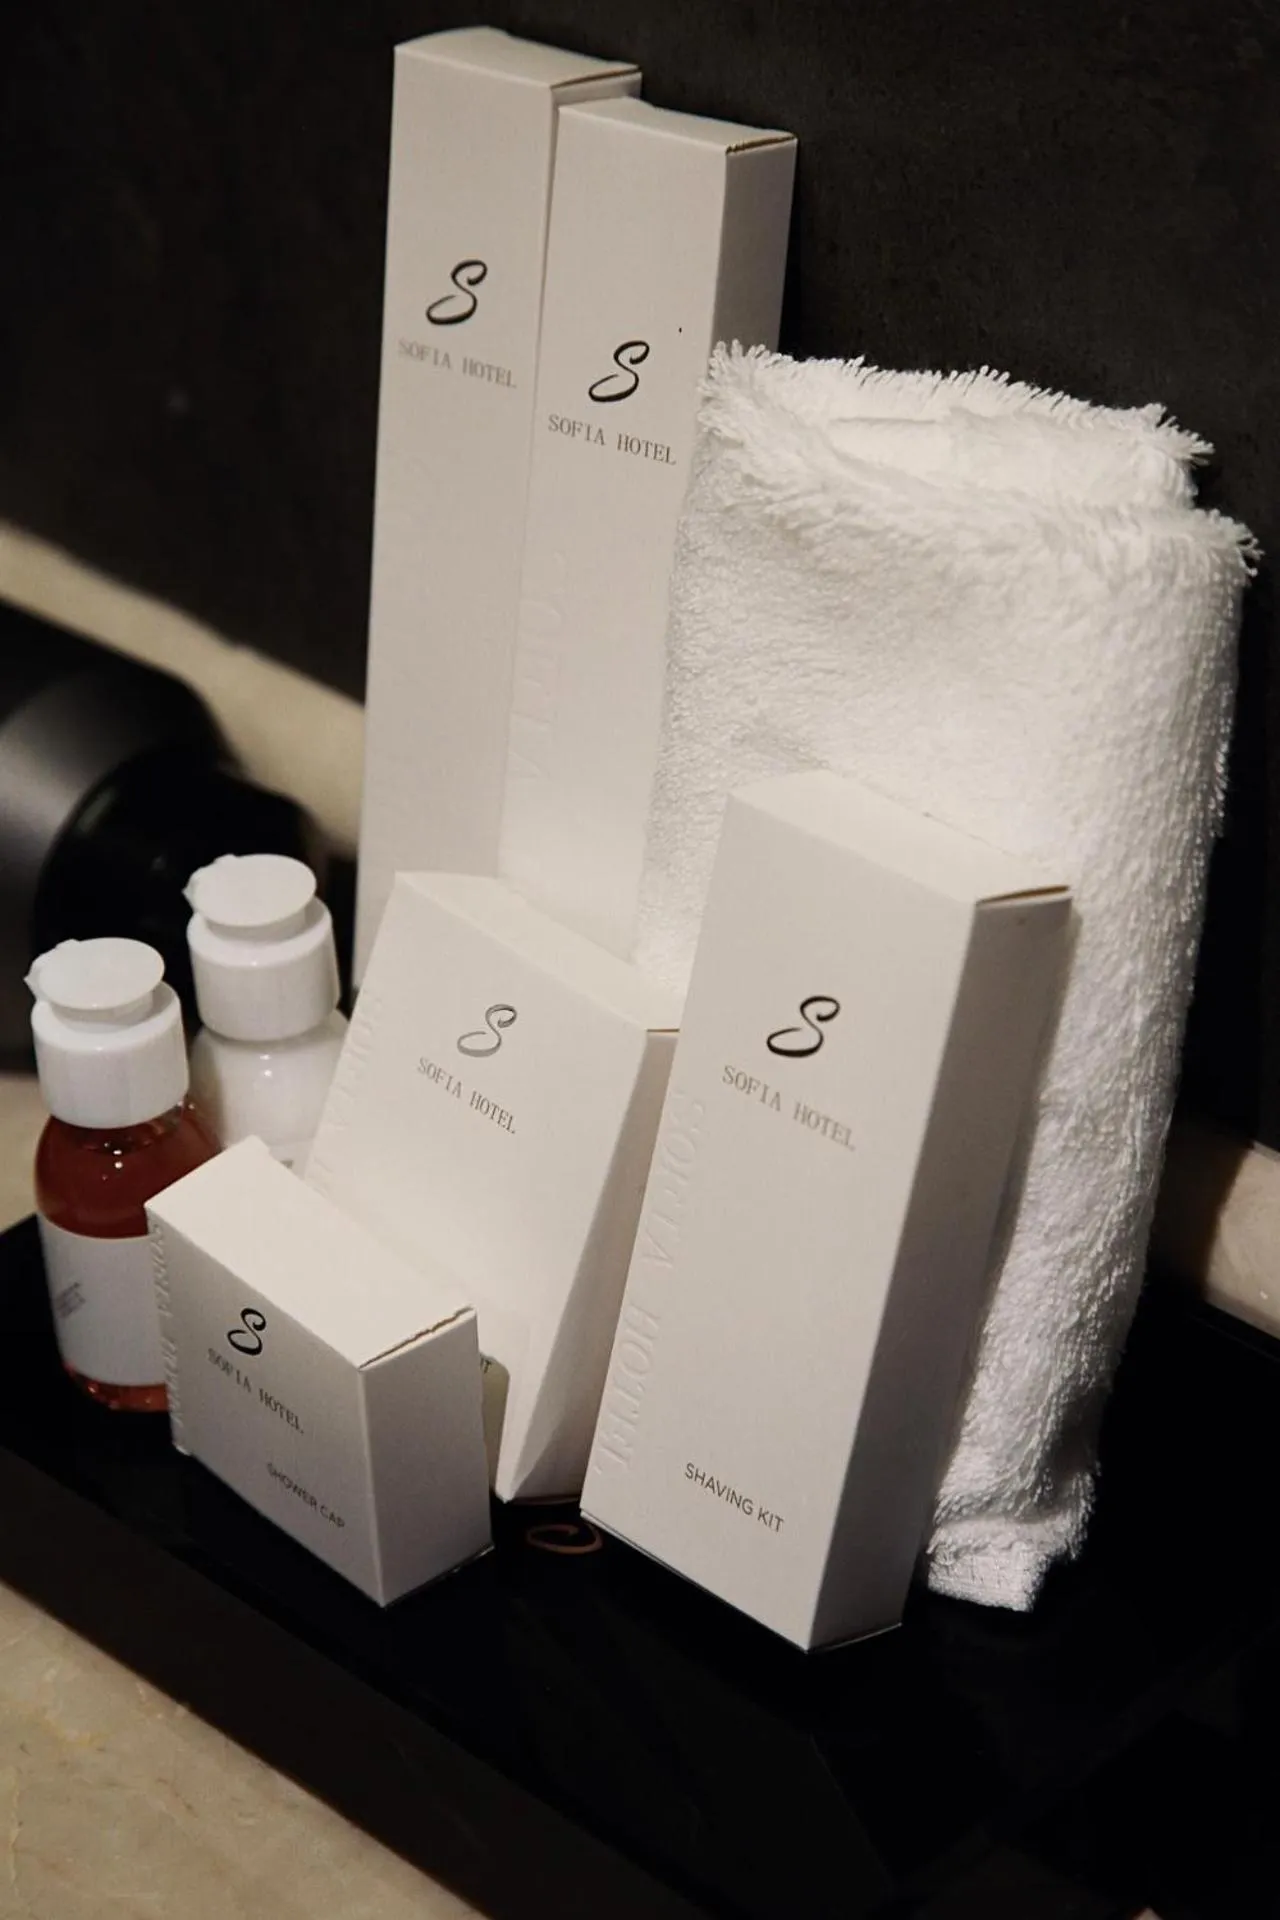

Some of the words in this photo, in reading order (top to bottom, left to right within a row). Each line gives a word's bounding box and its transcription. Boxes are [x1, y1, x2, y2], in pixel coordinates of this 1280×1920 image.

[426, 258, 488, 325] S
[398, 339, 452, 372] SOFIA
[461, 356, 518, 389] HOTEL
[588, 340, 650, 402] S
[547, 413, 607, 447] SOFIA
[616, 432, 677, 466] HOTEL
[766, 994, 841, 1059] S
[417, 1056, 463, 1099] SOFIA
[468, 1089, 516, 1135] HOTEL
[721, 1064, 783, 1112] SOFIA
[792, 1102, 857, 1152] HOTEL
[258, 1387, 305, 1435] HOTEL
[267, 1462, 319, 1512] SHOWER
[319, 1503, 346, 1529] CAP
[684, 1461, 754, 1517] SHAVING
[757, 1505, 785, 1534] KIT
